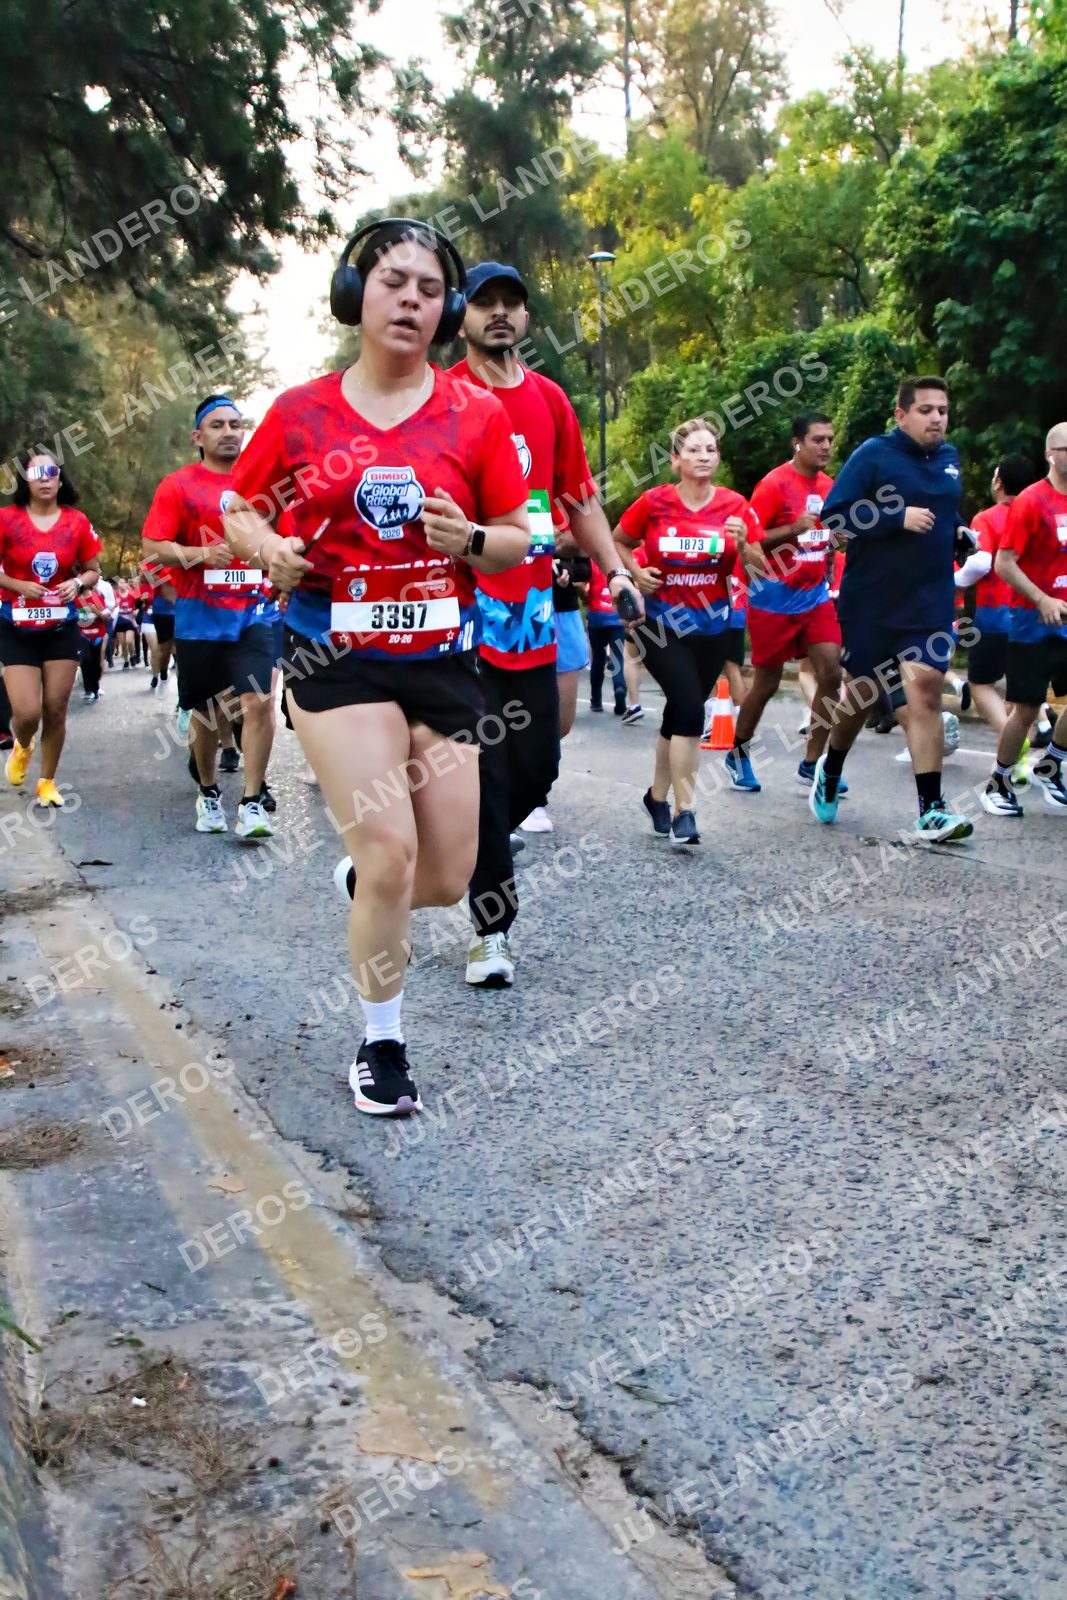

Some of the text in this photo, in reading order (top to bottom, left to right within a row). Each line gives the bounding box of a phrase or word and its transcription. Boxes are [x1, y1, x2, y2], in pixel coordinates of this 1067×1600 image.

[372, 484, 408, 496] Global
[366, 495, 394, 506] Race
[381, 529, 400, 538] 2026
[680, 538, 704, 551] 1873
[225, 571, 245, 582] 2110
[27, 608, 52, 619] 2393
[371, 602, 428, 630] 3397
